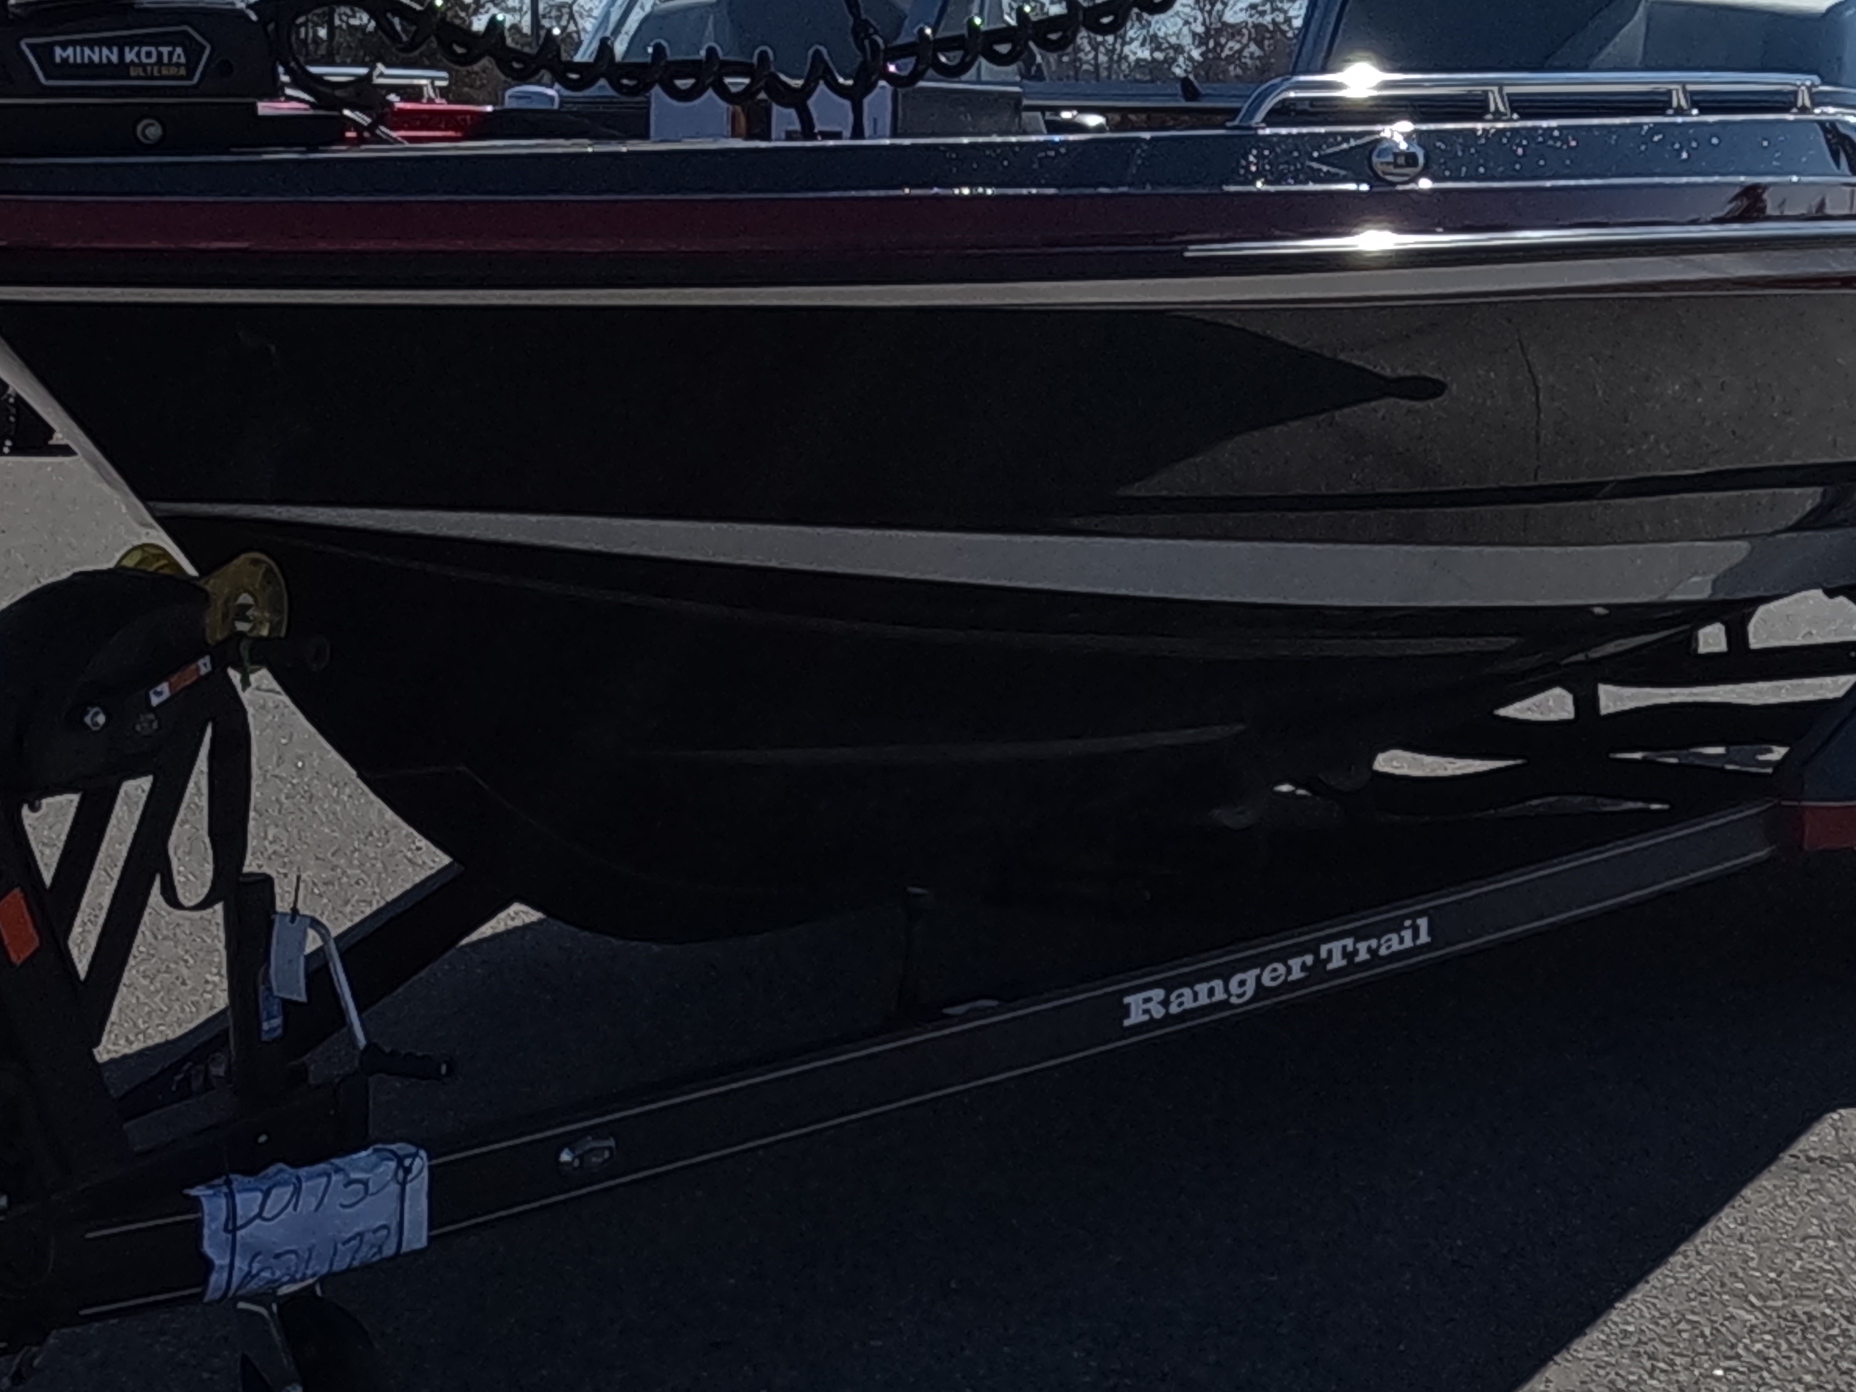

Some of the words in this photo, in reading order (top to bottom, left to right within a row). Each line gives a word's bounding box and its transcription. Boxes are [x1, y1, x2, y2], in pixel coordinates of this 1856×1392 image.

[53, 45, 119, 64] MINN
[124, 46, 187, 64] KOTA
[1122, 953, 1314, 1027] Ranger
[1320, 916, 1432, 971] Trail
